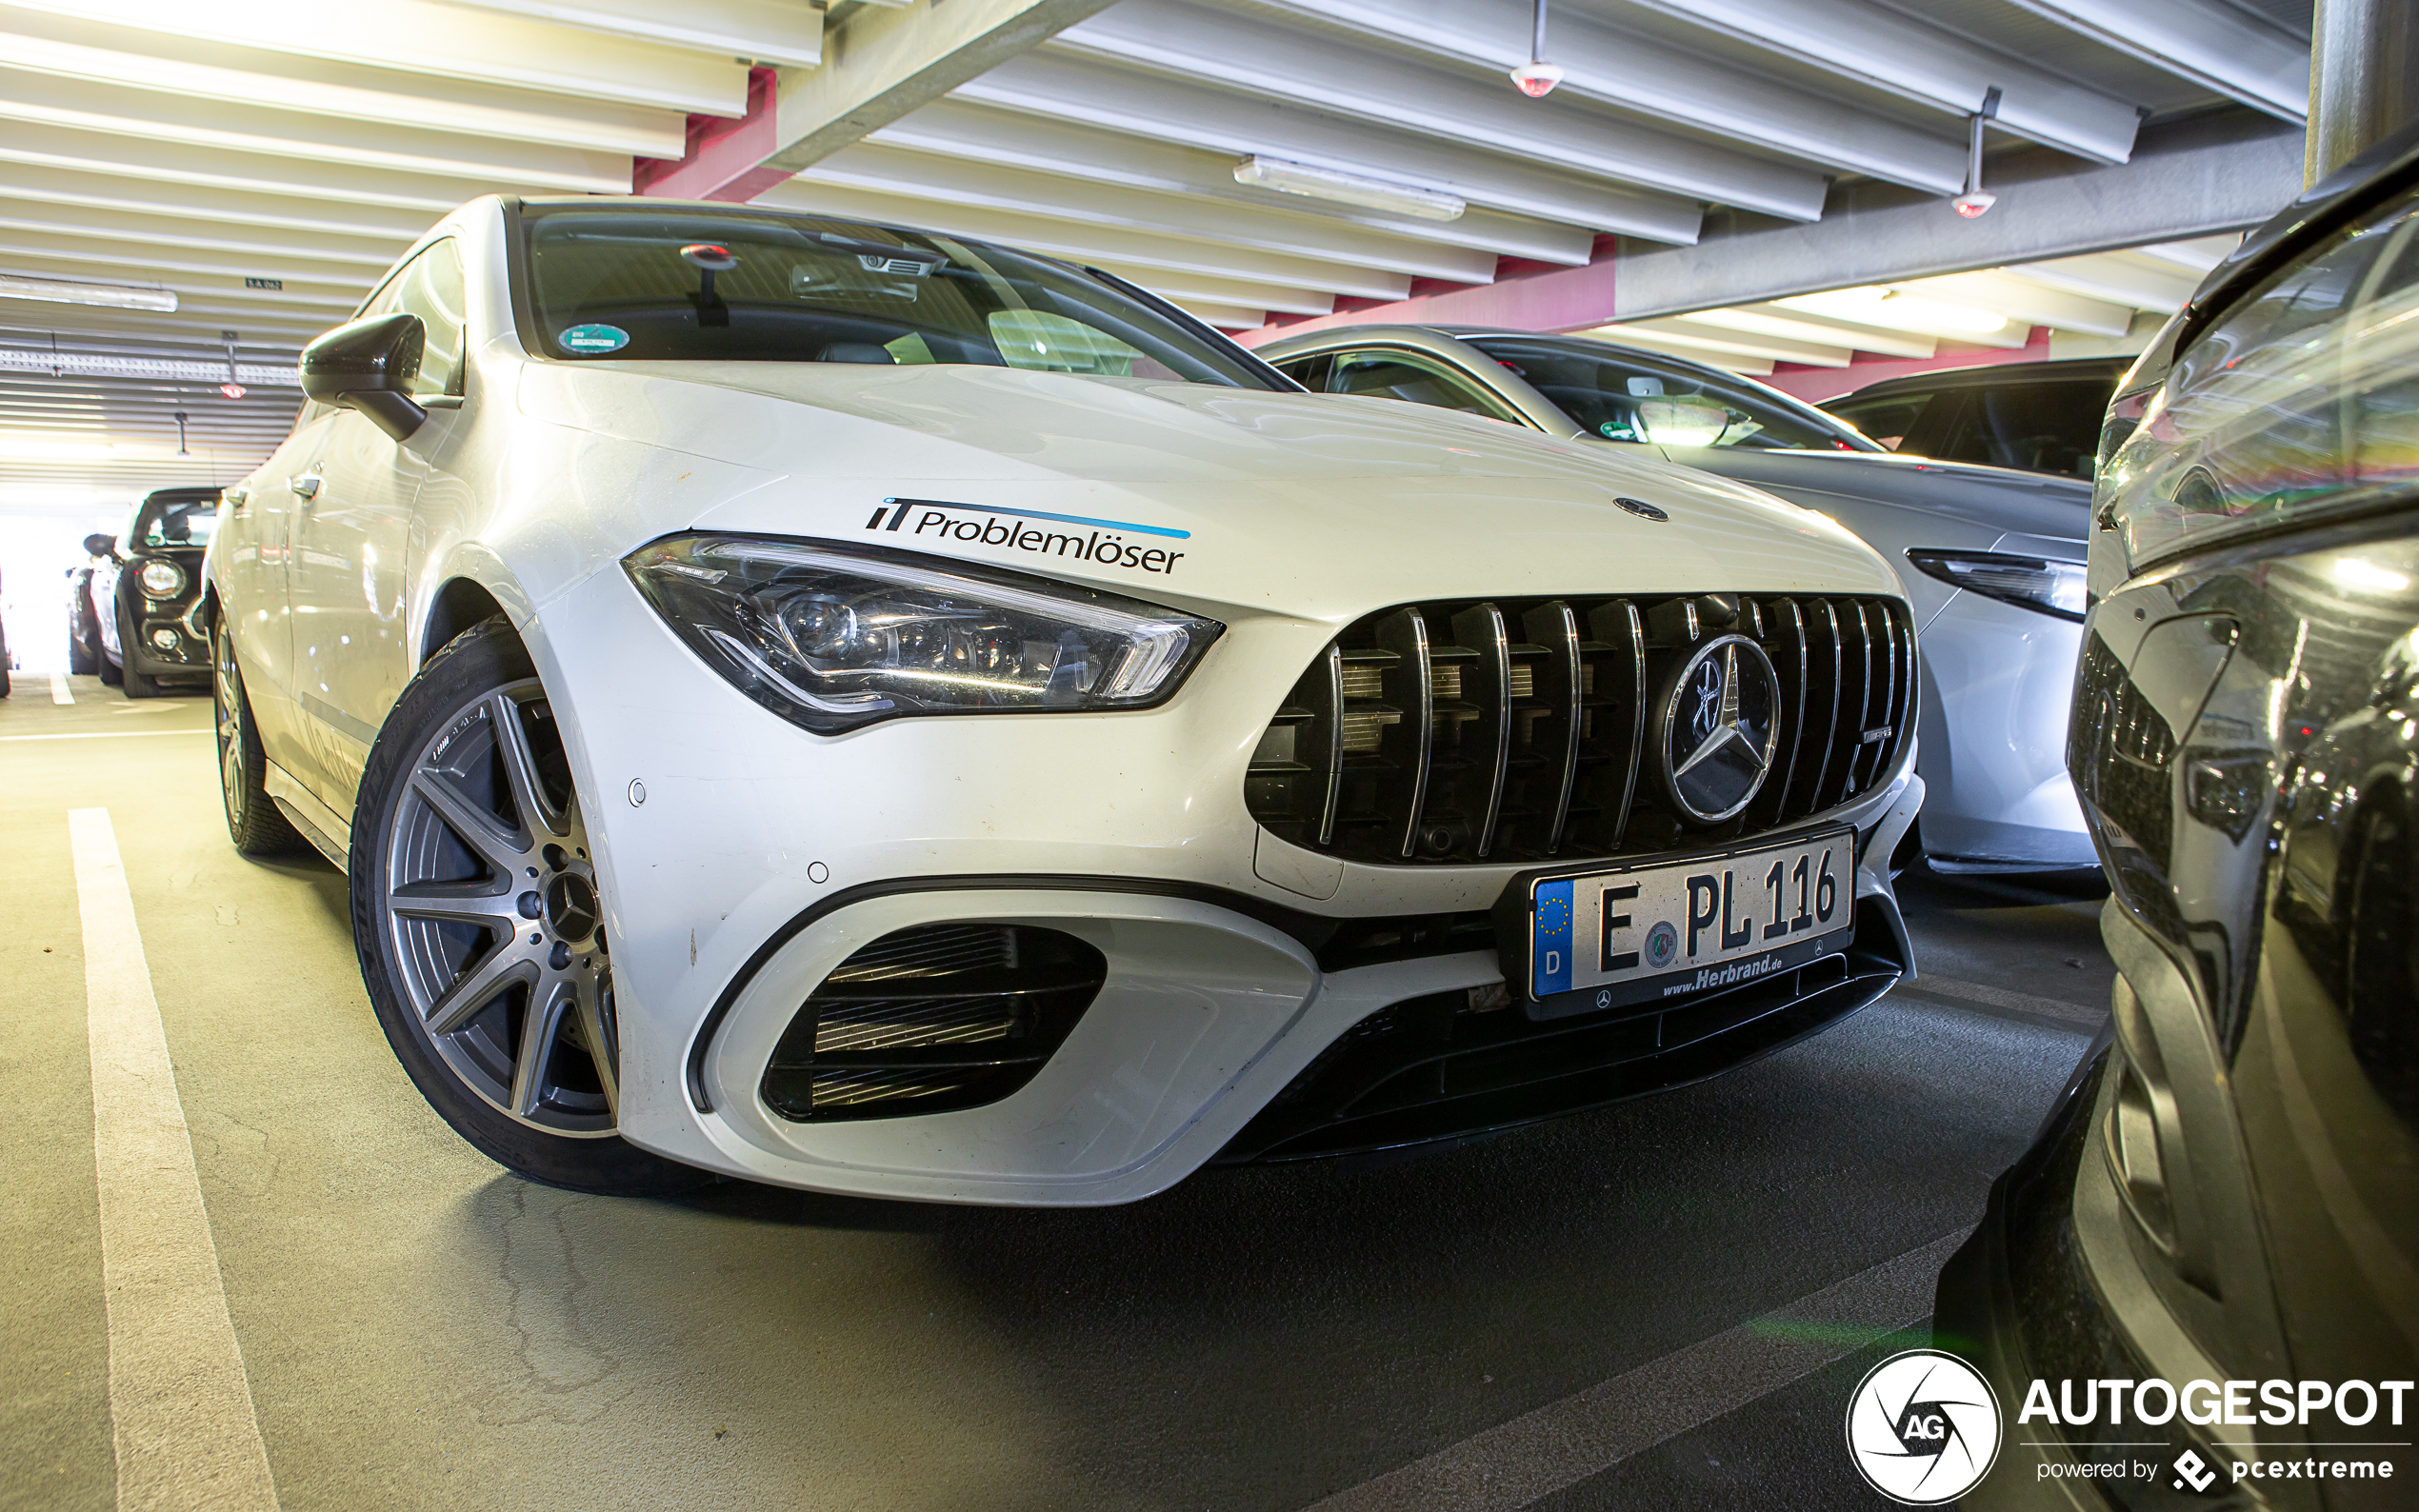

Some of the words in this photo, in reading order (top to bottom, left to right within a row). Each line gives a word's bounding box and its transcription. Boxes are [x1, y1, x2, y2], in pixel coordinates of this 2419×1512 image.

[914, 511, 1185, 575] Problemlöser
[1600, 885, 1640, 972] E
[1686, 870, 1751, 957] PL
[1763, 848, 1836, 941] 116
[1545, 950, 1561, 976] D
[1663, 954, 1783, 996] www.Herbrand.de
